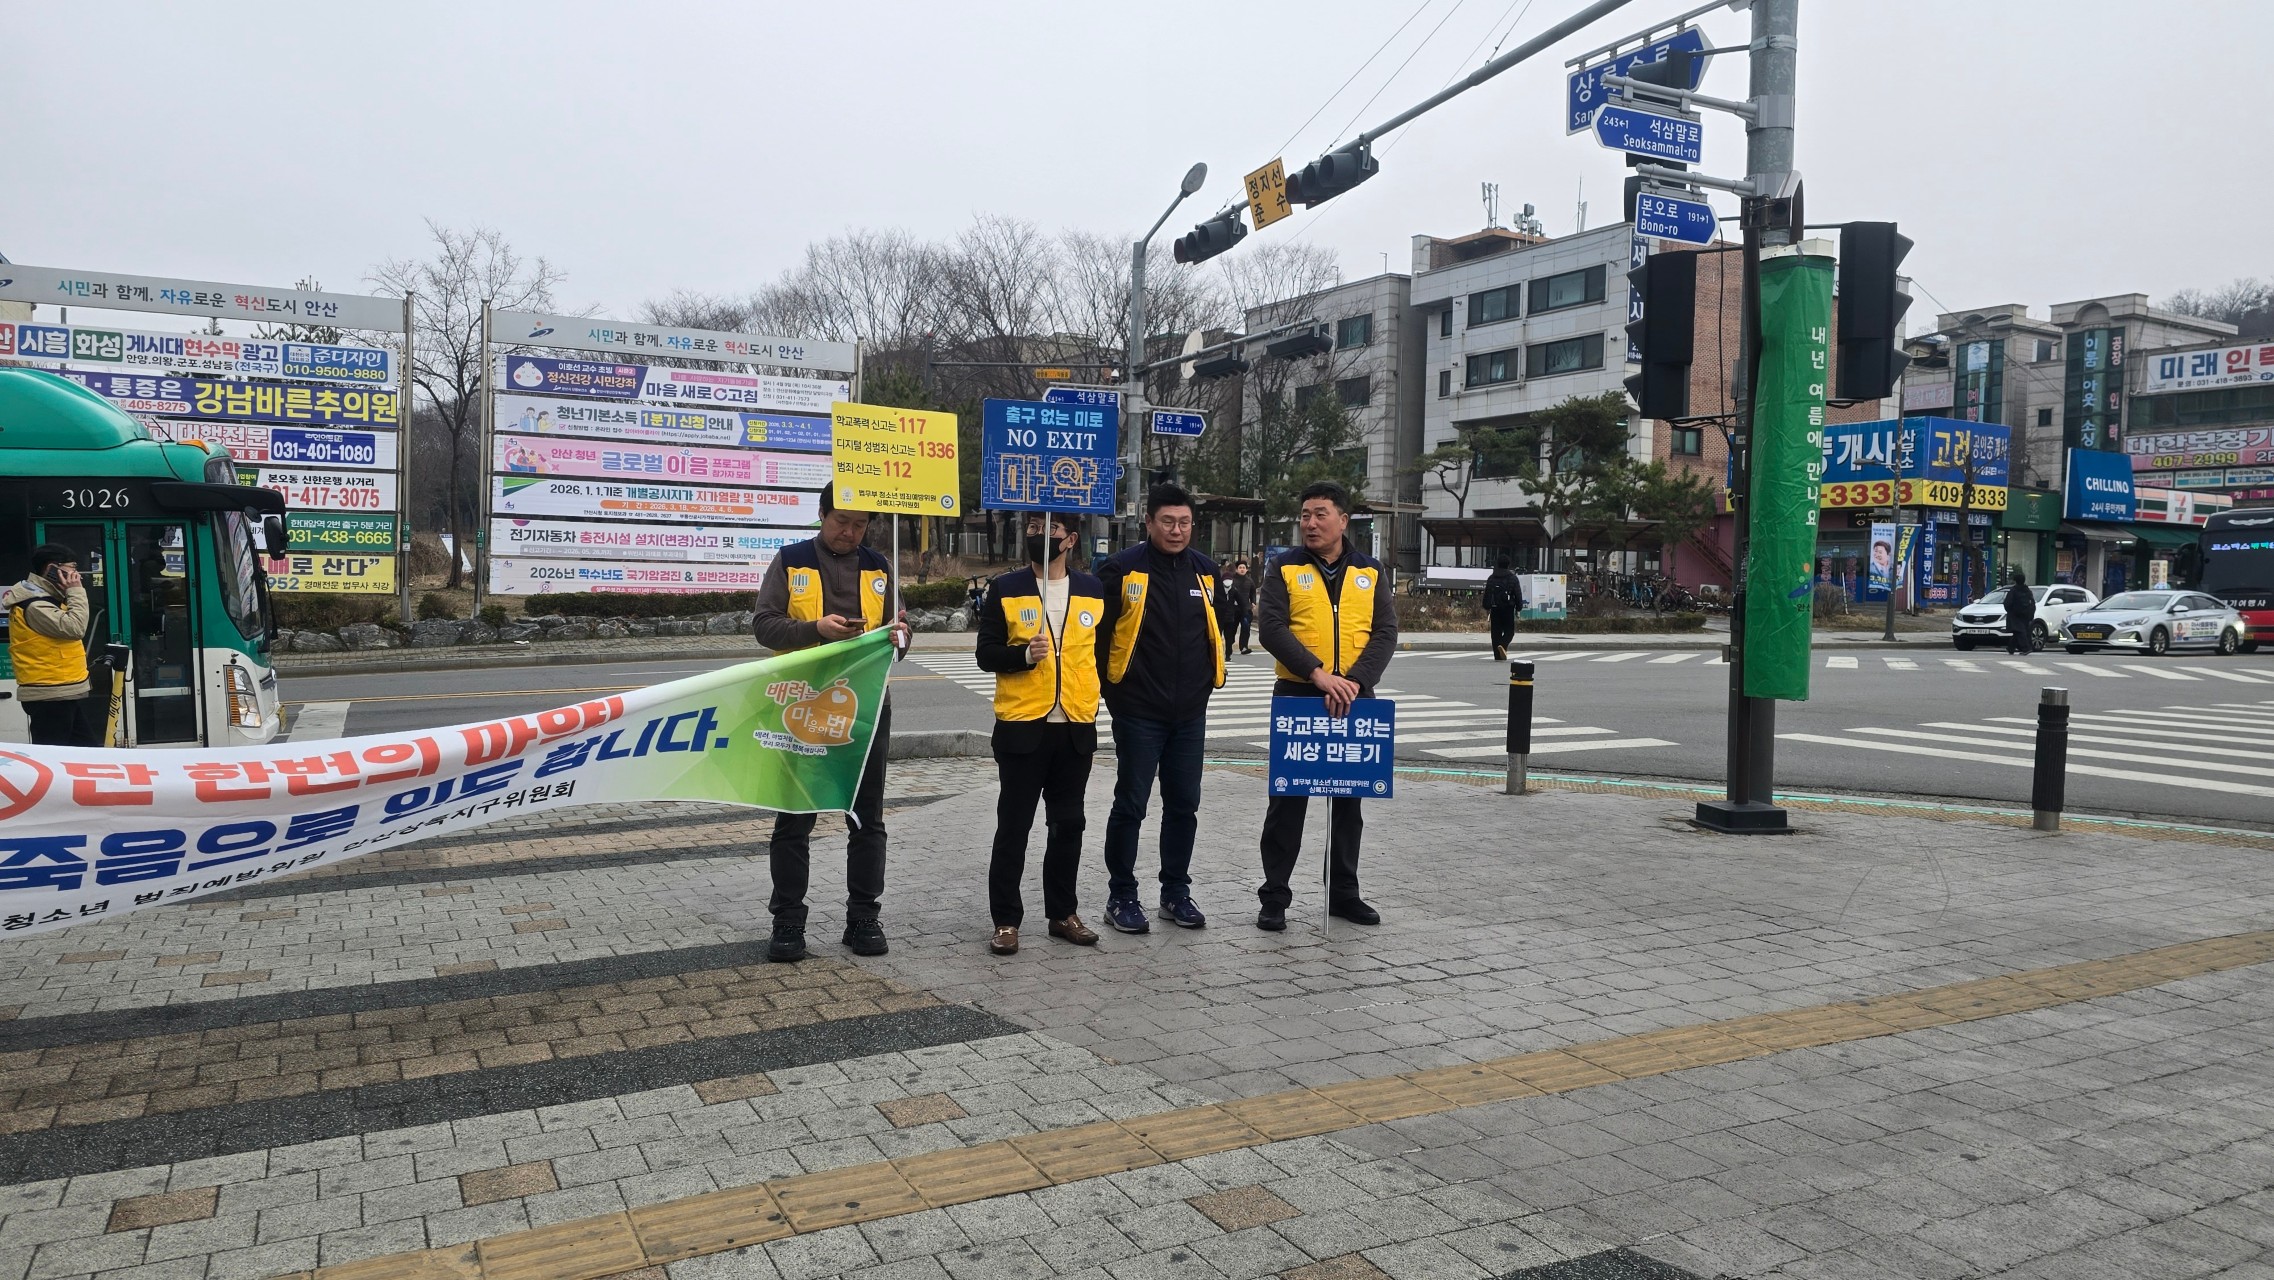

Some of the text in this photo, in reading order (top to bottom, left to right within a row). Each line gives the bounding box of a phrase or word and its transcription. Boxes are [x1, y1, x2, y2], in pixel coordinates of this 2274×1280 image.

[1604, 115, 1699, 145] 243 석삼말로
[1623, 133, 1698, 160] Seoksammal-ro
[1248, 165, 1283, 199] 정지선
[1641, 198, 1700, 223] 본오로 191
[1641, 219, 1678, 236] Bono-ro
[57, 279, 338, 318] 시민과 함께, 자유로운 혁신도시 안산
[21, 329, 121, 358] 시흥 화성
[588, 328, 804, 361] 시민과 함께, 자유로운 혁신도시 안산
[314, 348, 382, 367] 준디자인
[581, 363, 597, 373] 교수
[598, 364, 613, 374] 초빙
[284, 364, 386, 381] 010-9500-9880
[547, 371, 637, 389] 정신건강 시민강좌
[110, 376, 182, 399] 통증은
[194, 382, 397, 423] 강남바른추의원
[646, 382, 677, 397] 마음
[1076, 391, 1117, 403] 석삼말로
[128, 399, 187, 412] 405-8275
[556, 405, 733, 431] 청년기본소득 1분기 신청 안내
[835, 415, 927, 436] 학교폭력 신고는 117
[1006, 406, 1104, 428] 출구 없는 미로
[1156, 414, 1183, 425] 본오로
[177, 423, 269, 448] 대행전문
[1007, 429, 1097, 451] NO EXIT
[2126, 427, 2274, 455] 대한보청기
[273, 441, 373, 462] 031-401-1080
[836, 438, 863, 452] 디지털
[863, 440, 889, 455] 성범죄
[889, 442, 916, 457] 신고는
[917, 440, 955, 460] 1336
[1932, 429, 1971, 467] 고려
[551, 448, 750, 476] 안산 청년 글로벌 이음 프로그램
[837, 460, 854, 474] 범죄
[855, 462, 881, 477] 신고는
[882, 460, 912, 479] 112
[2152, 451, 2239, 468] 407-2999
[267, 473, 375, 487] 본오동 신한은행 사거리
[712, 470, 750, 479] 참가자 모집
[62, 487, 130, 509] 3026
[550, 484, 583, 495] 2026.
[625, 486, 693, 501] 개별공시지가
[696, 491, 741, 503] 지가열람
[743, 492, 754, 504] 및
[756, 493, 800, 506] 의견제출
[858, 489, 878, 498] 법무부
[876, 499, 920, 509] 상록지구위원회
[326, 520, 341, 530] 2번
[360, 521, 374, 530] 5분
[375, 521, 393, 531] 거리
[288, 529, 392, 545] 031-438-6665
[510, 529, 576, 543] 전기자동차
[580, 531, 631, 545] 충전시설
[635, 533, 718, 548] 설치(변경)신고
[722, 536, 734, 549] 및
[737, 536, 785, 549] 책임보험
[304, 581, 340, 590] 경매전문
[342, 581, 369, 590] 법무사
[530, 566, 760, 583] 2026년 짝수년도 국가암검진 & 일반건강검진
[766, 681, 819, 704] 배려는
[826, 713, 847, 738] 법
[1275, 715, 1390, 738] 학교폭력 없는
[1283, 742, 1381, 764] 세상 만들기
[60, 736, 441, 806] 단 한번의
[0, 705, 729, 891] 죽음으로 합니다.
[1, 899, 110, 932] 청소년
[134, 850, 326, 905] 범죄예방위원
